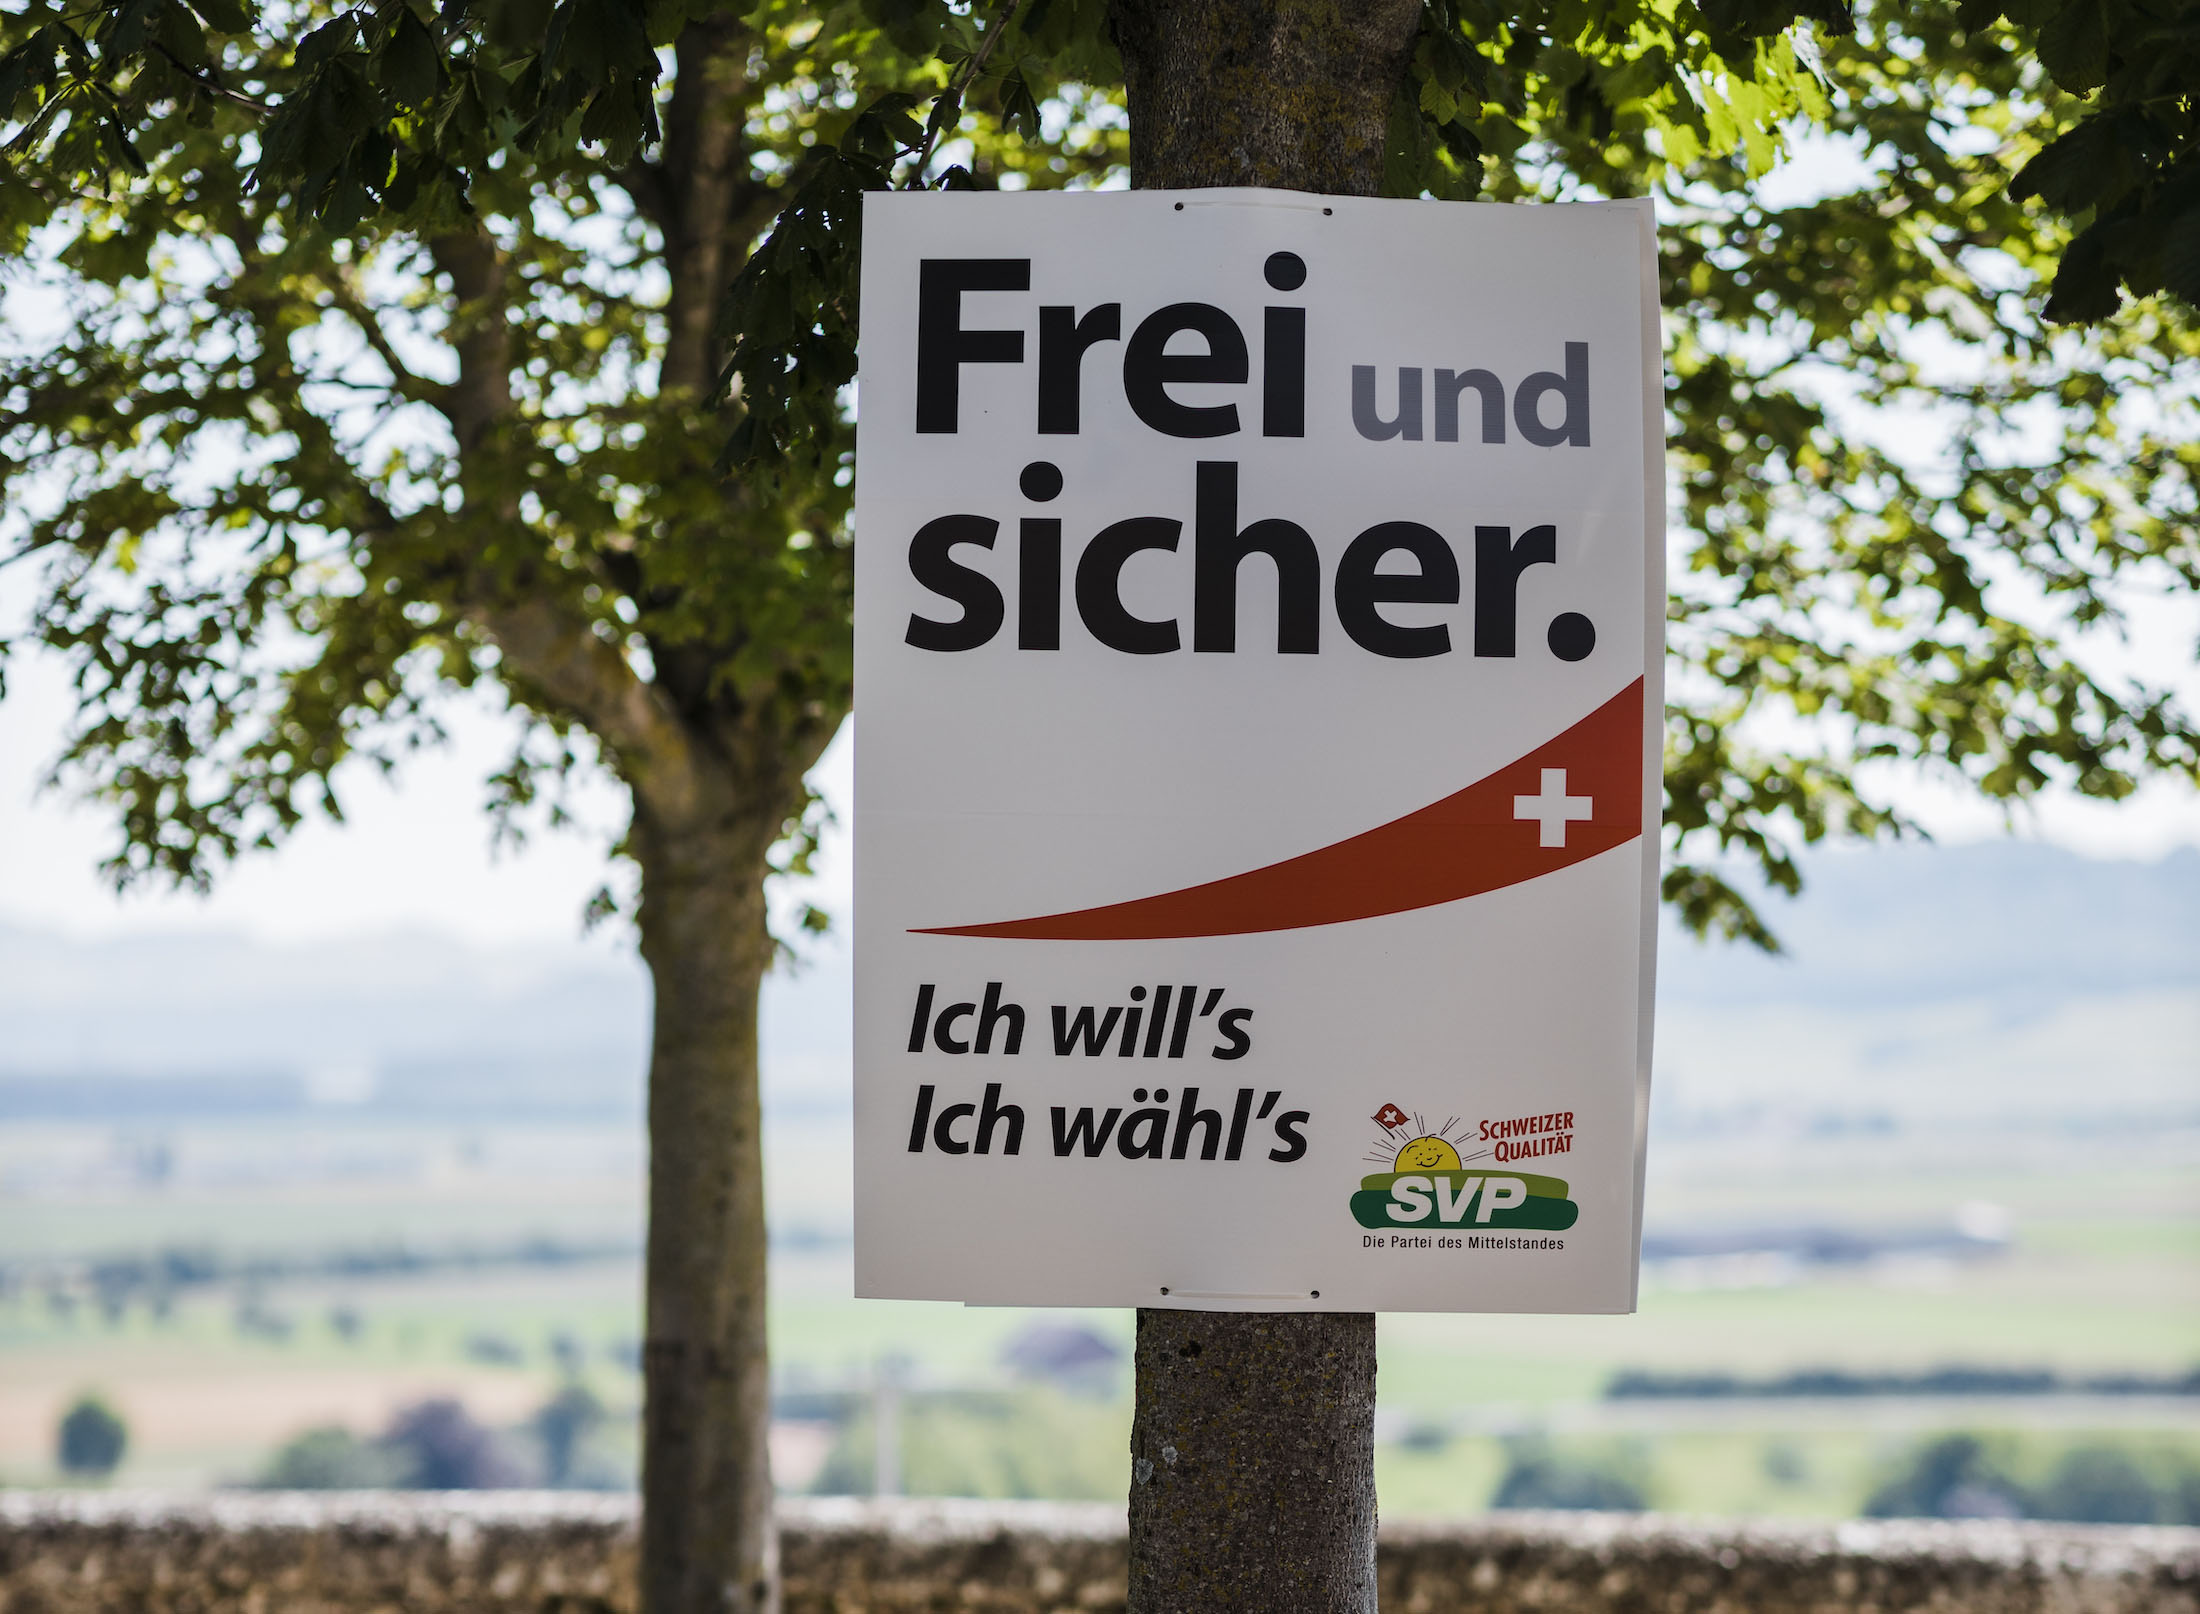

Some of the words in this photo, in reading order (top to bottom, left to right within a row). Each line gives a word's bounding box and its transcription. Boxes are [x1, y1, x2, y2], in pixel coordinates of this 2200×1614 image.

[916, 250, 1308, 439] Frei
[1351, 341, 1591, 448] und
[904, 460, 1597, 663] sicher.
[907, 981, 1026, 1056] Ich
[907, 1082, 1026, 1156] Ich
[1479, 1111, 1574, 1141] SCHWEIZER
[1494, 1132, 1574, 1163] QUALITÄT
[1385, 1175, 1528, 1223] SVP
[1362, 1235, 1385, 1249] Die
[1391, 1235, 1432, 1249] Partei
[1438, 1236, 1462, 1249] des
[1468, 1236, 1565, 1250] Mittelstandes
